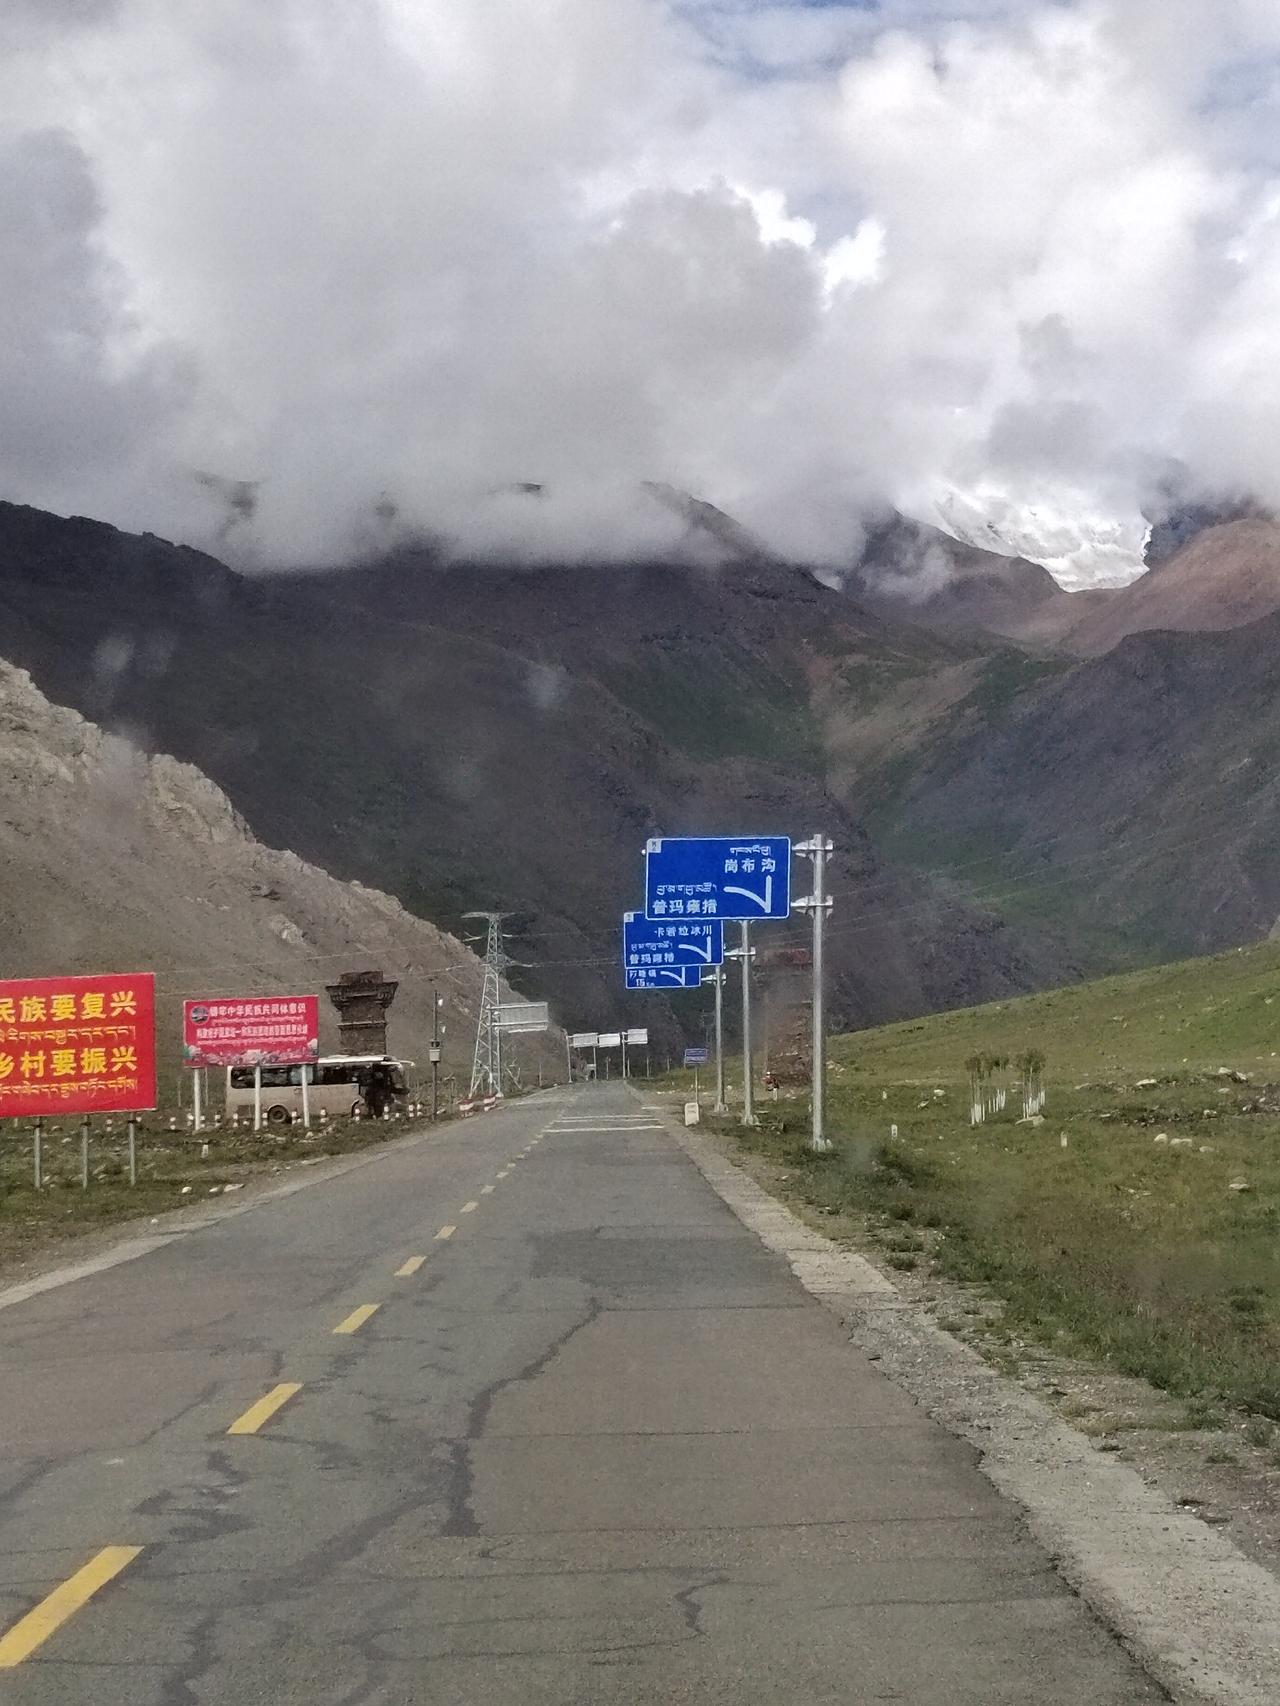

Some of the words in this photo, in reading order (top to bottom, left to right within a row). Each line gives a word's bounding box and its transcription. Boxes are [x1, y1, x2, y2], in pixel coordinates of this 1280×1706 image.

[0, 991, 137, 1024] 民族要复兴
[0, 1046, 138, 1080] 乡村要振兴
